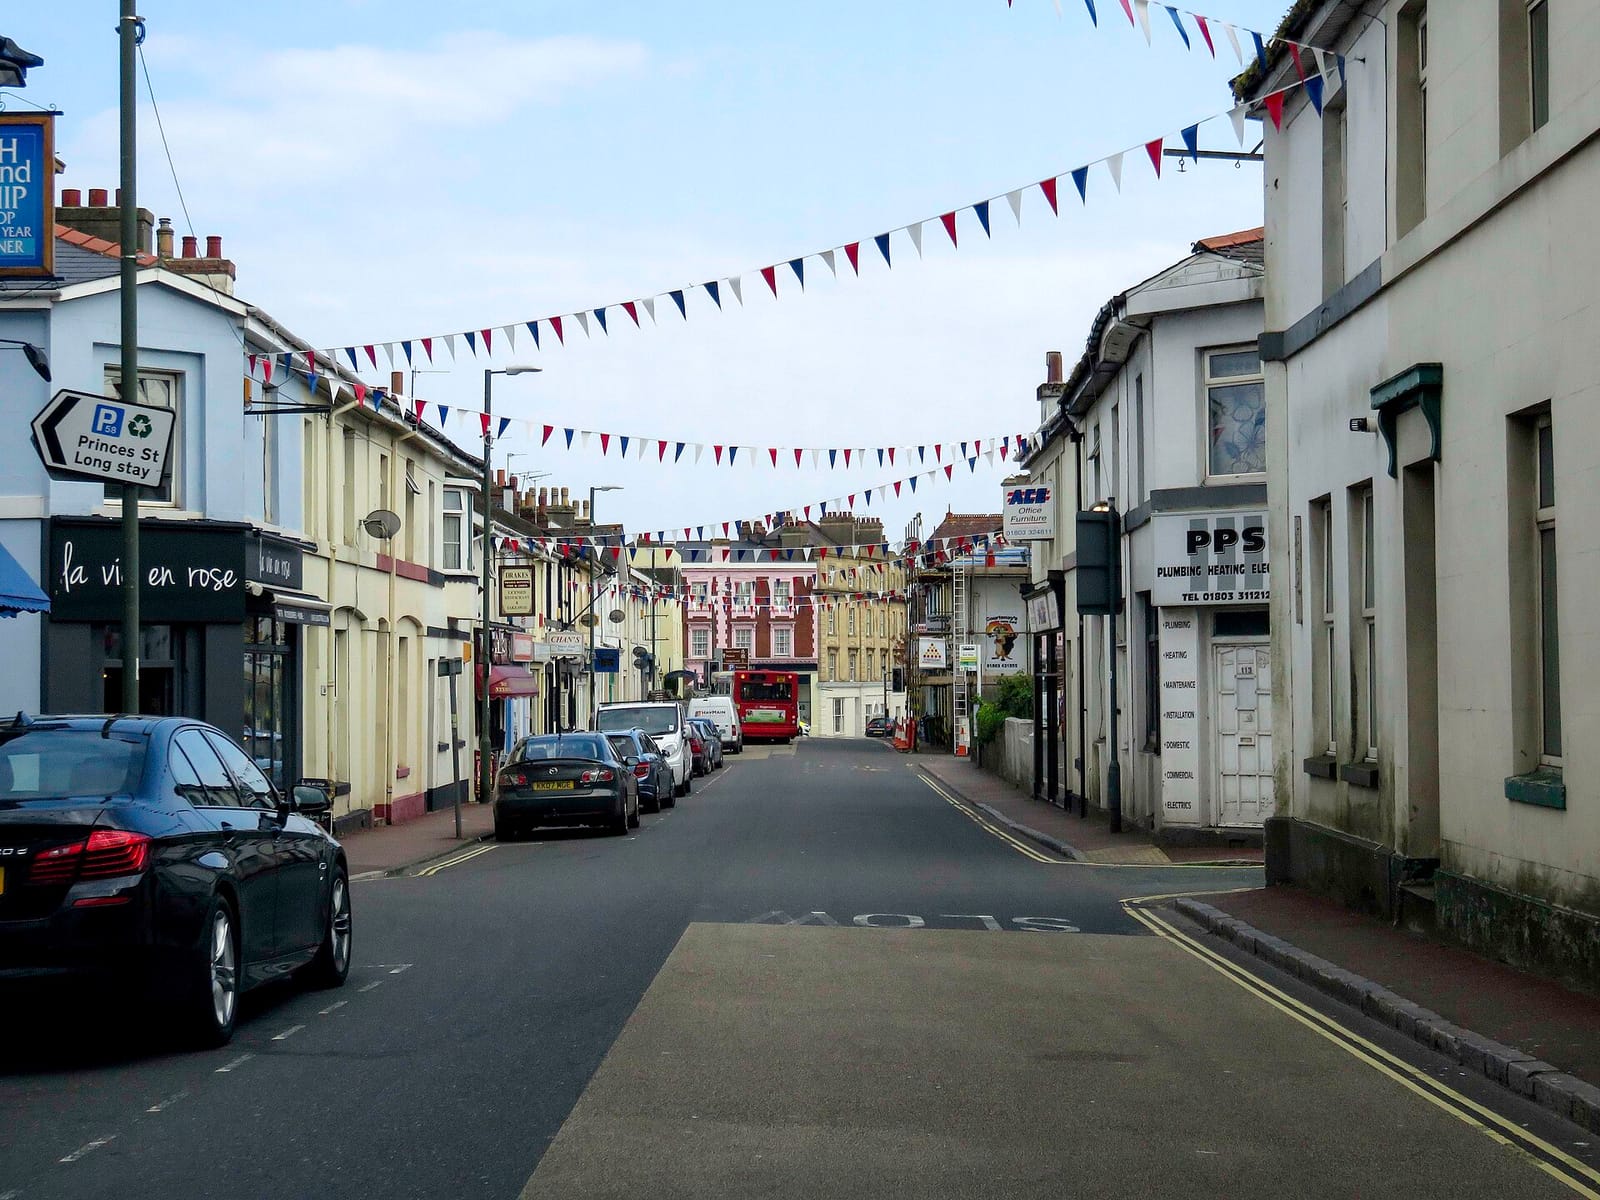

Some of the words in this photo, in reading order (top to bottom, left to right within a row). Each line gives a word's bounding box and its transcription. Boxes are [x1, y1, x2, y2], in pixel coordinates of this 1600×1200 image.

[2, 226, 32, 238] YEAR
[96, 407, 118, 433] P
[78, 435, 135, 458] Princes
[140, 448, 160, 463] St
[74, 451, 112, 472] Long
[116, 461, 150, 480] stay
[1018, 507, 1043, 515] Office
[1010, 515, 1047, 523] Furniture
[1186, 526, 1266, 556] PPS
[60, 541, 89, 593] la
[102, 558, 124, 586] vi
[148, 566, 176, 587] en
[188, 567, 238, 592] rose
[1157, 565, 1202, 578] PLUMBING
[1207, 563, 1245, 576] HEATING
[1182, 593, 1200, 602] TEL
[1202, 591, 1234, 601] 01803
[1165, 620, 1191, 629] PLUMBING
[1165, 650, 1188, 659] HEATING
[1165, 680, 1196, 689] MAINTENANCE
[1166, 711, 1195, 719] INSTALLATION
[1166, 740, 1190, 749] DOMESTIC
[1167, 770, 1194, 779] COMMERCIAL
[1167, 801, 1192, 810] ELECTRICS
